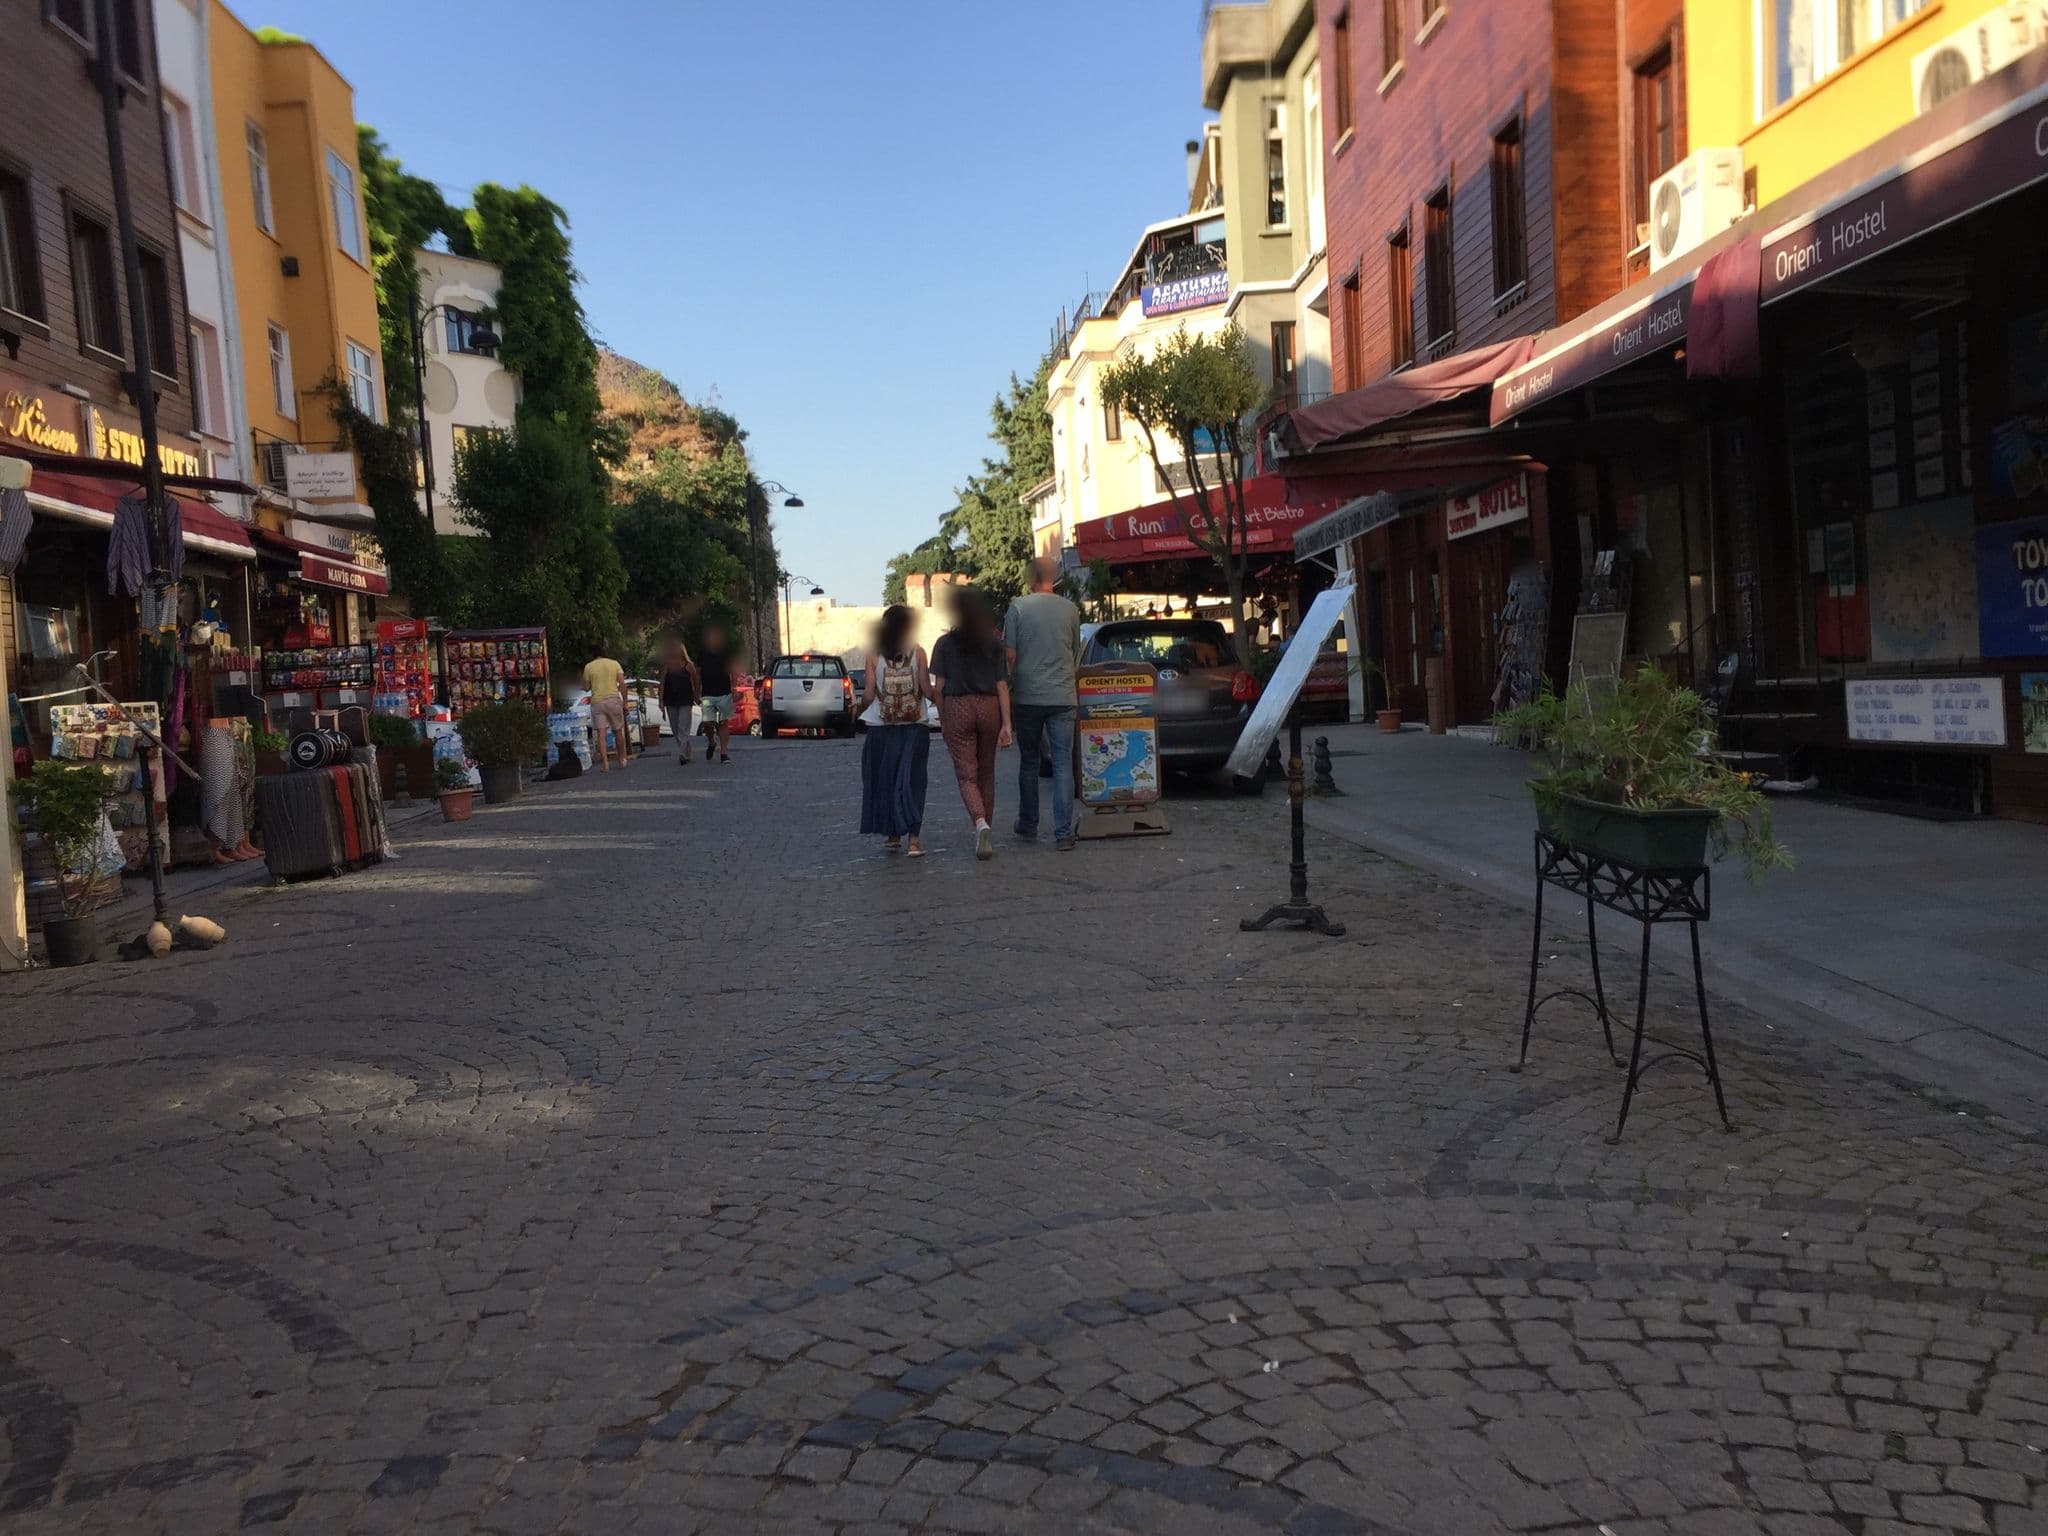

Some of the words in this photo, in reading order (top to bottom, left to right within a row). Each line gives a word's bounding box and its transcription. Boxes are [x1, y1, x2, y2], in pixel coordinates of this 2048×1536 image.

[1775, 237, 1823, 282] Orient
[1831, 199, 1887, 256] Hostel
[1612, 322, 1643, 356] Orient
[1648, 299, 1683, 338] Hostel
[1505, 383, 1526, 409] Orient
[1529, 367, 1554, 397] Hostel
[1263, 504, 1305, 521] Bistro
[349, 573, 367, 589] GIDA
[1086, 677, 1114, 687] ORIENT
[1116, 676, 1147, 685] HOSTEL
